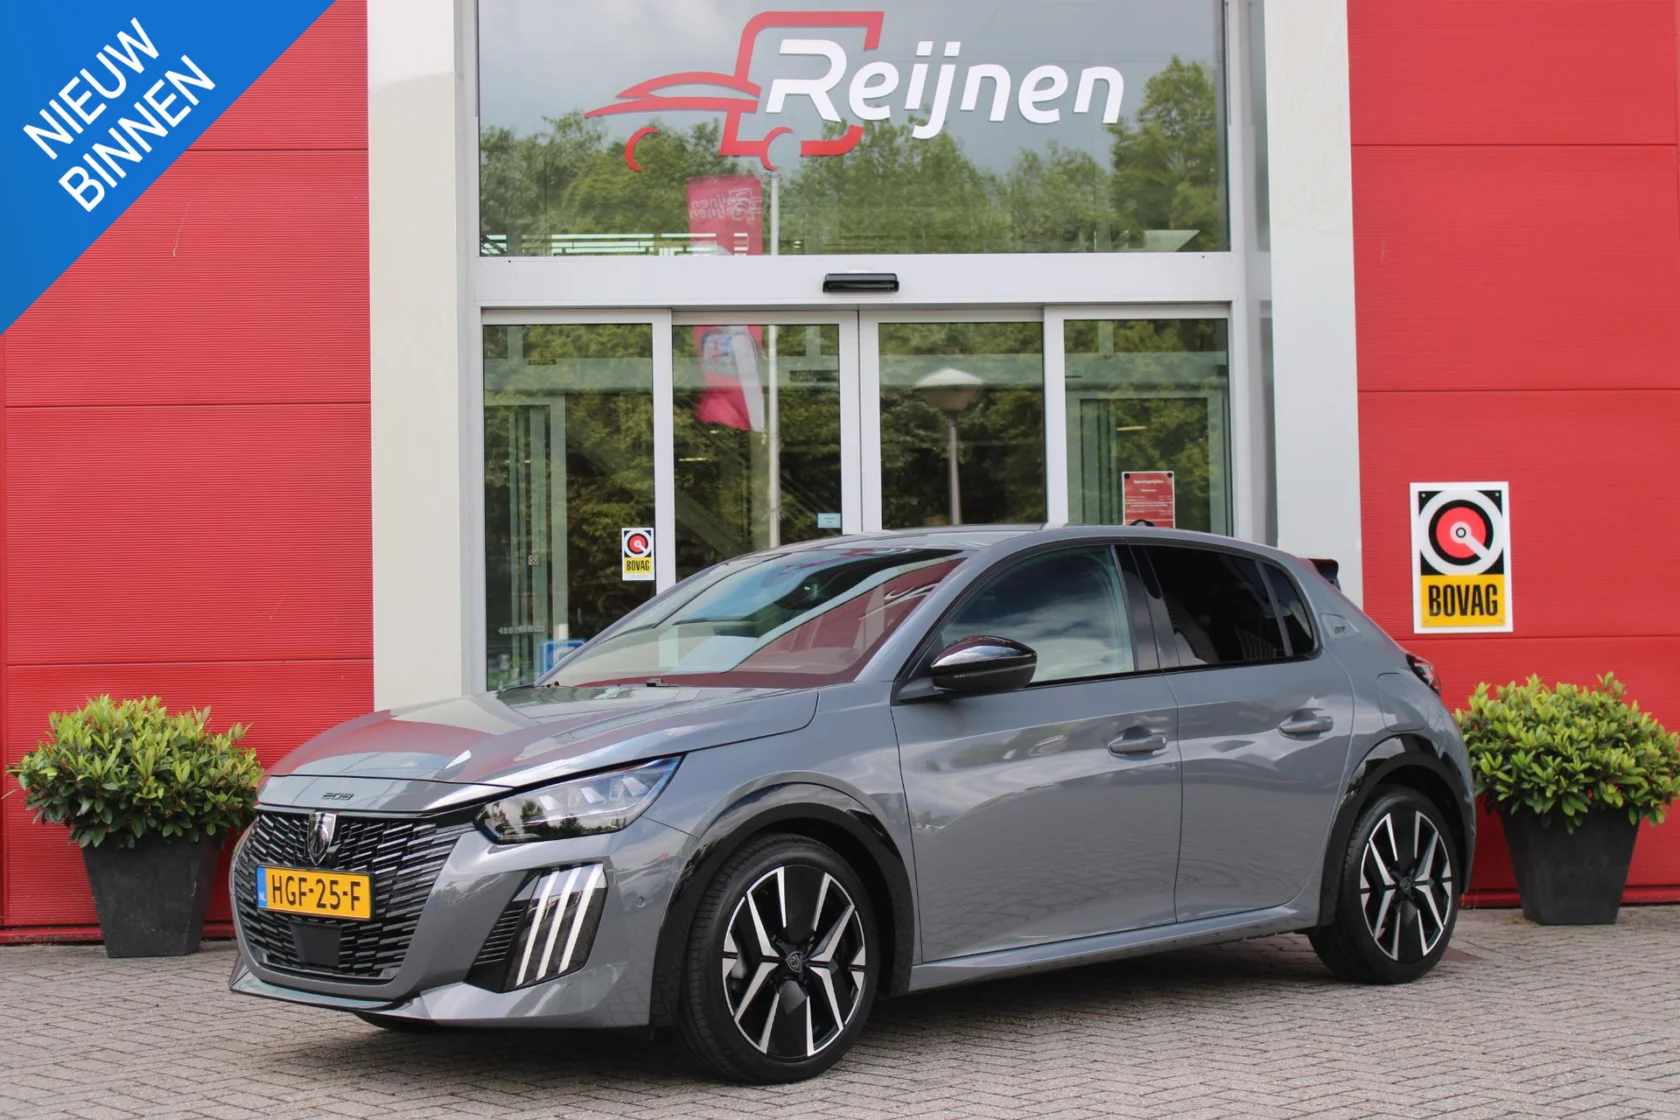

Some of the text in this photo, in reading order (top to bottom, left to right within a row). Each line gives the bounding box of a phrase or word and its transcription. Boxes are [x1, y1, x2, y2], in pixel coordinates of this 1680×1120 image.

[765, 39, 1125, 139] Reijnen
[626, 560, 650, 571] BOVAG
[1428, 584, 1498, 617] BOVAG
[271, 874, 361, 912] HGF-25-F
